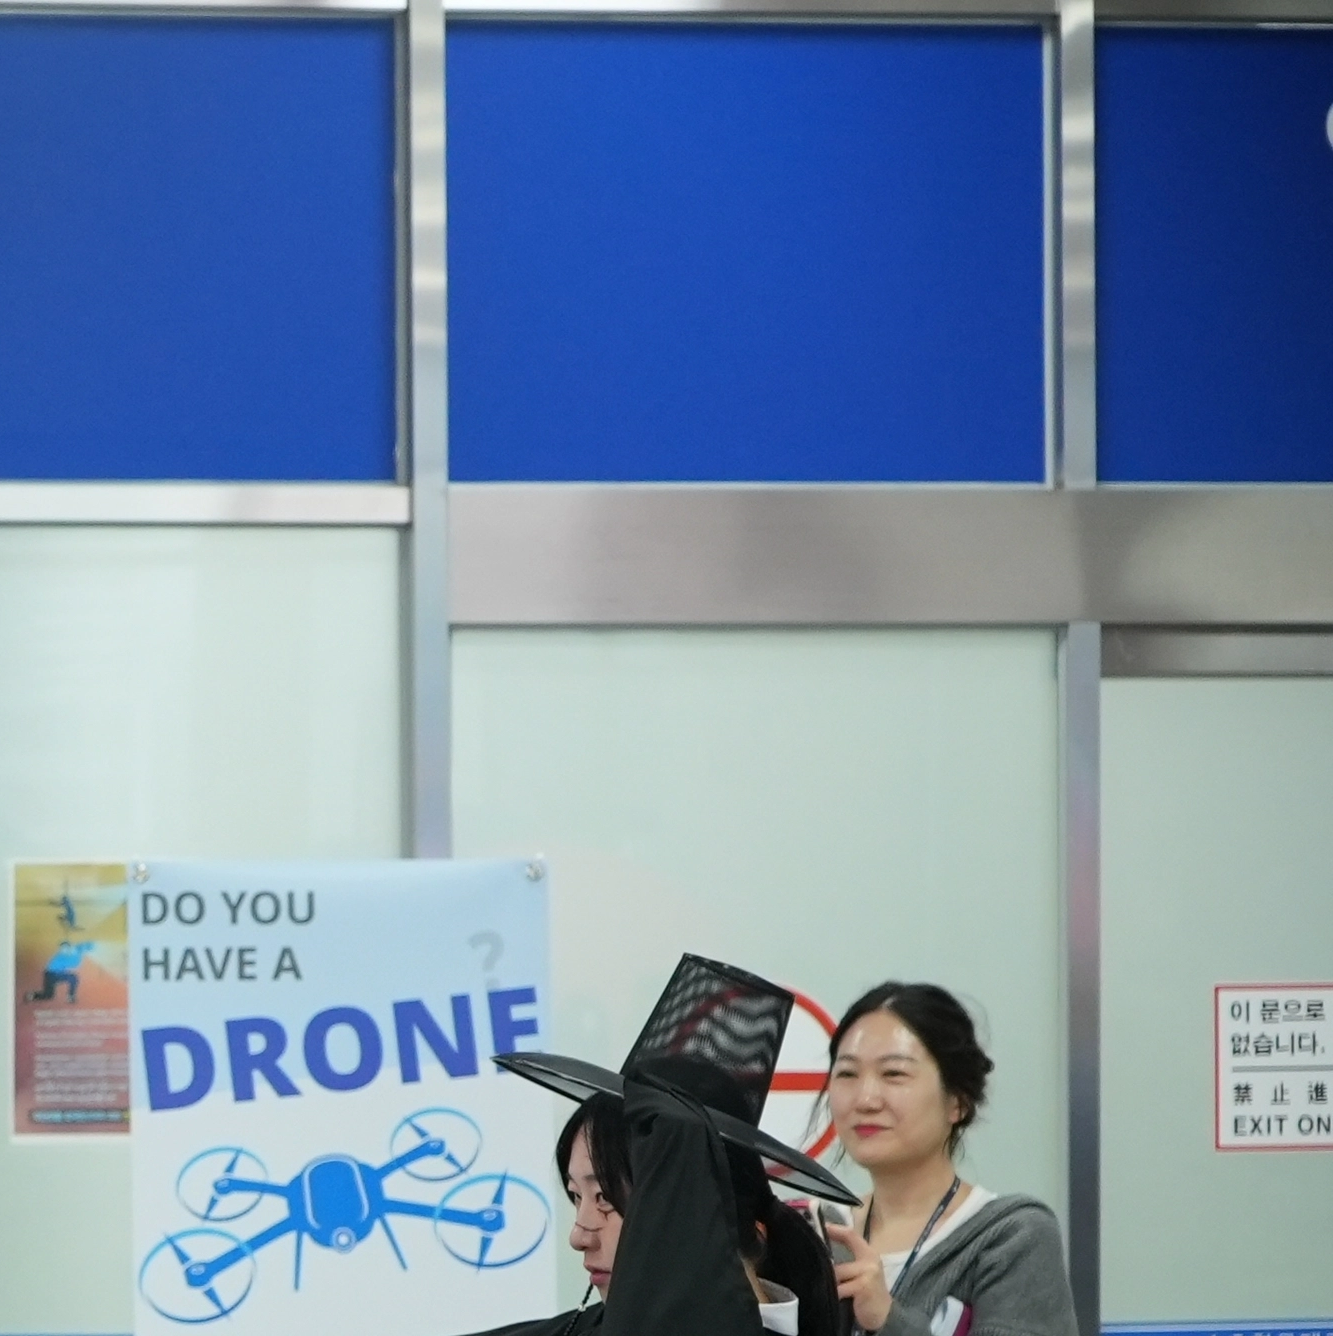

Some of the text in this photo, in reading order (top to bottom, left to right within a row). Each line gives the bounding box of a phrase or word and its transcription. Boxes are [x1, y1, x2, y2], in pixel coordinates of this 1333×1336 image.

[140, 890, 316, 926] DO YOU
[141, 946, 303, 982] HAVE A
[1230, 1000, 1251, 1023] 이
[140, 986, 540, 1112] DRONE
[1234, 1114, 1289, 1137] EXIT
